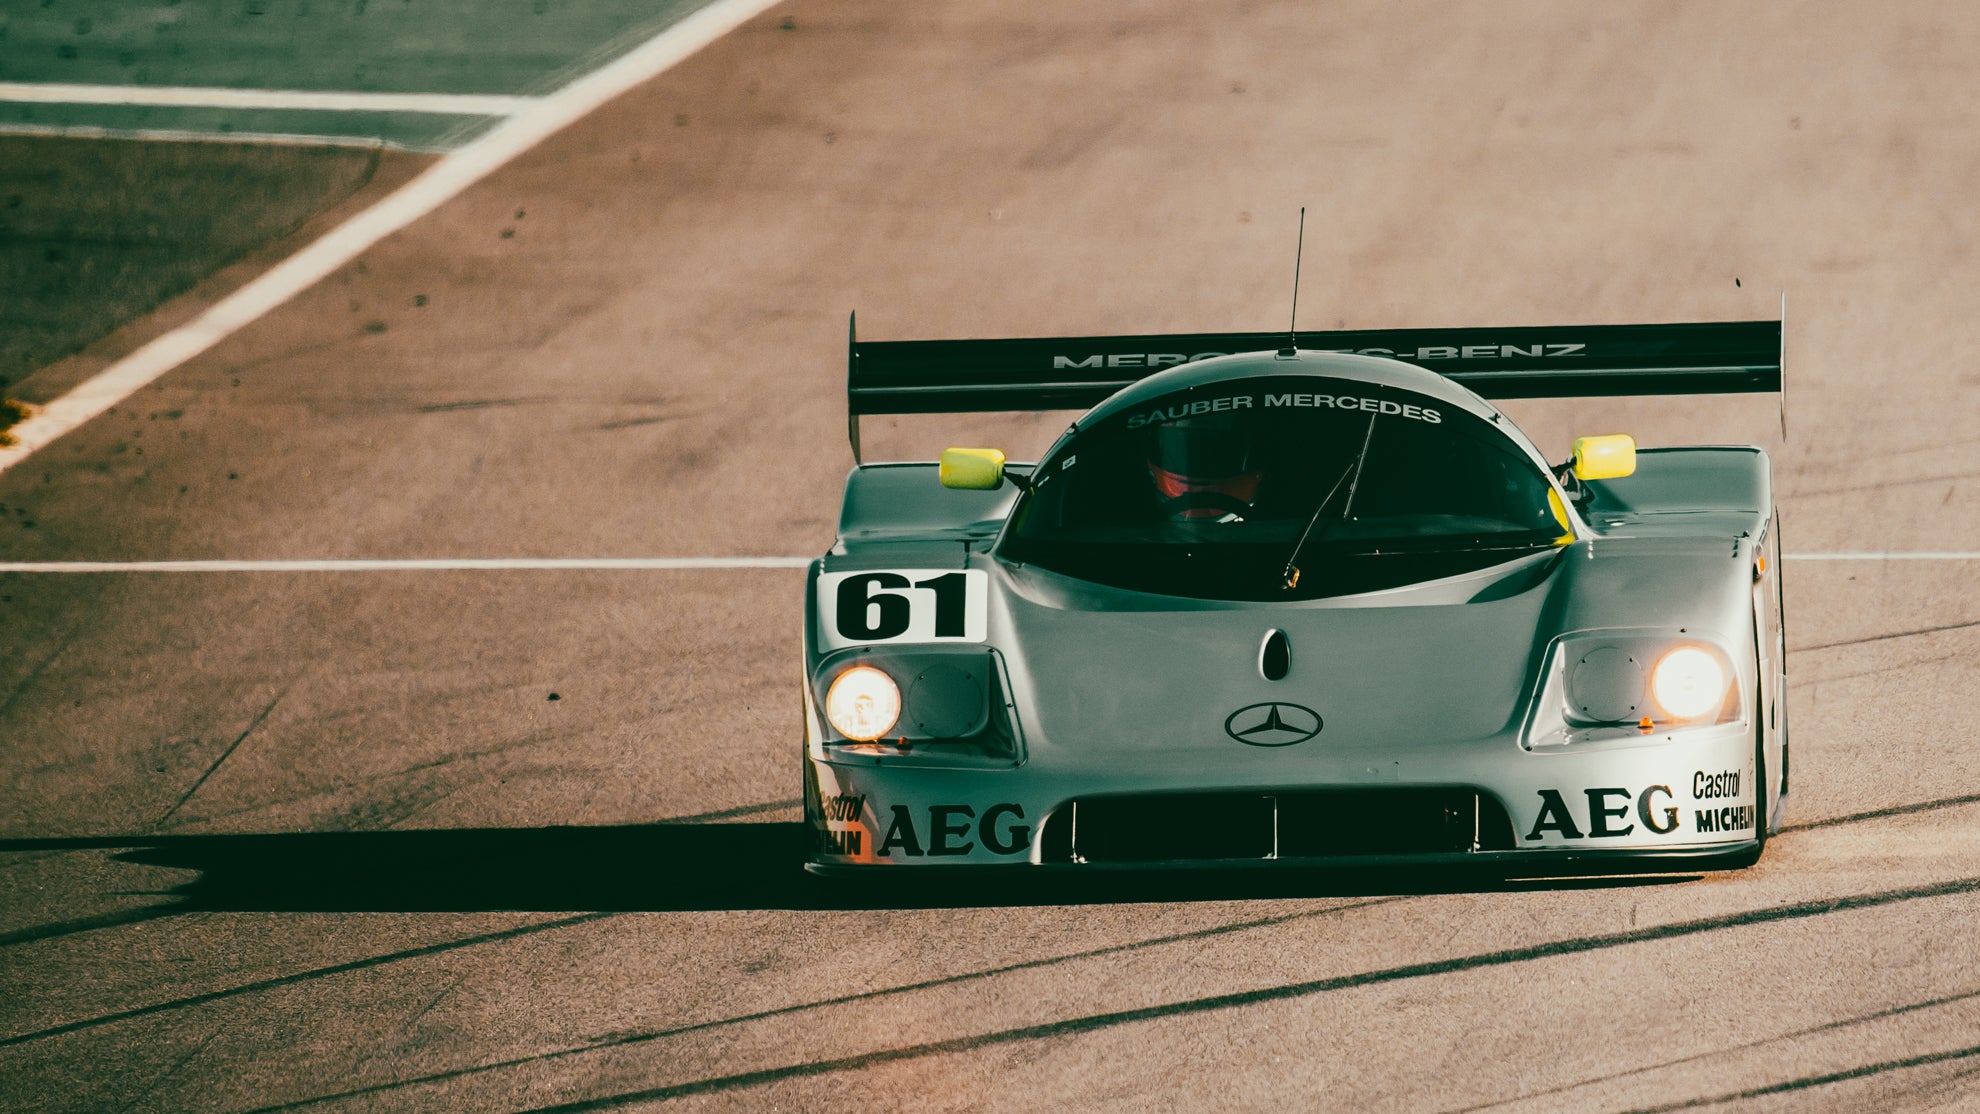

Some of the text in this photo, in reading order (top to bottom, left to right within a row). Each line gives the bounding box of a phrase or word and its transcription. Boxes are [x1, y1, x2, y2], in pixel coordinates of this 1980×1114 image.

[1053, 342, 1586, 369] MER-BENZ
[1127, 394, 1443, 430] SAUBER MERCEDES
[836, 572, 967, 641] 61
[1693, 769, 1740, 799] Castrol
[877, 803, 1031, 857] AEG
[1525, 785, 1680, 840] AEG
